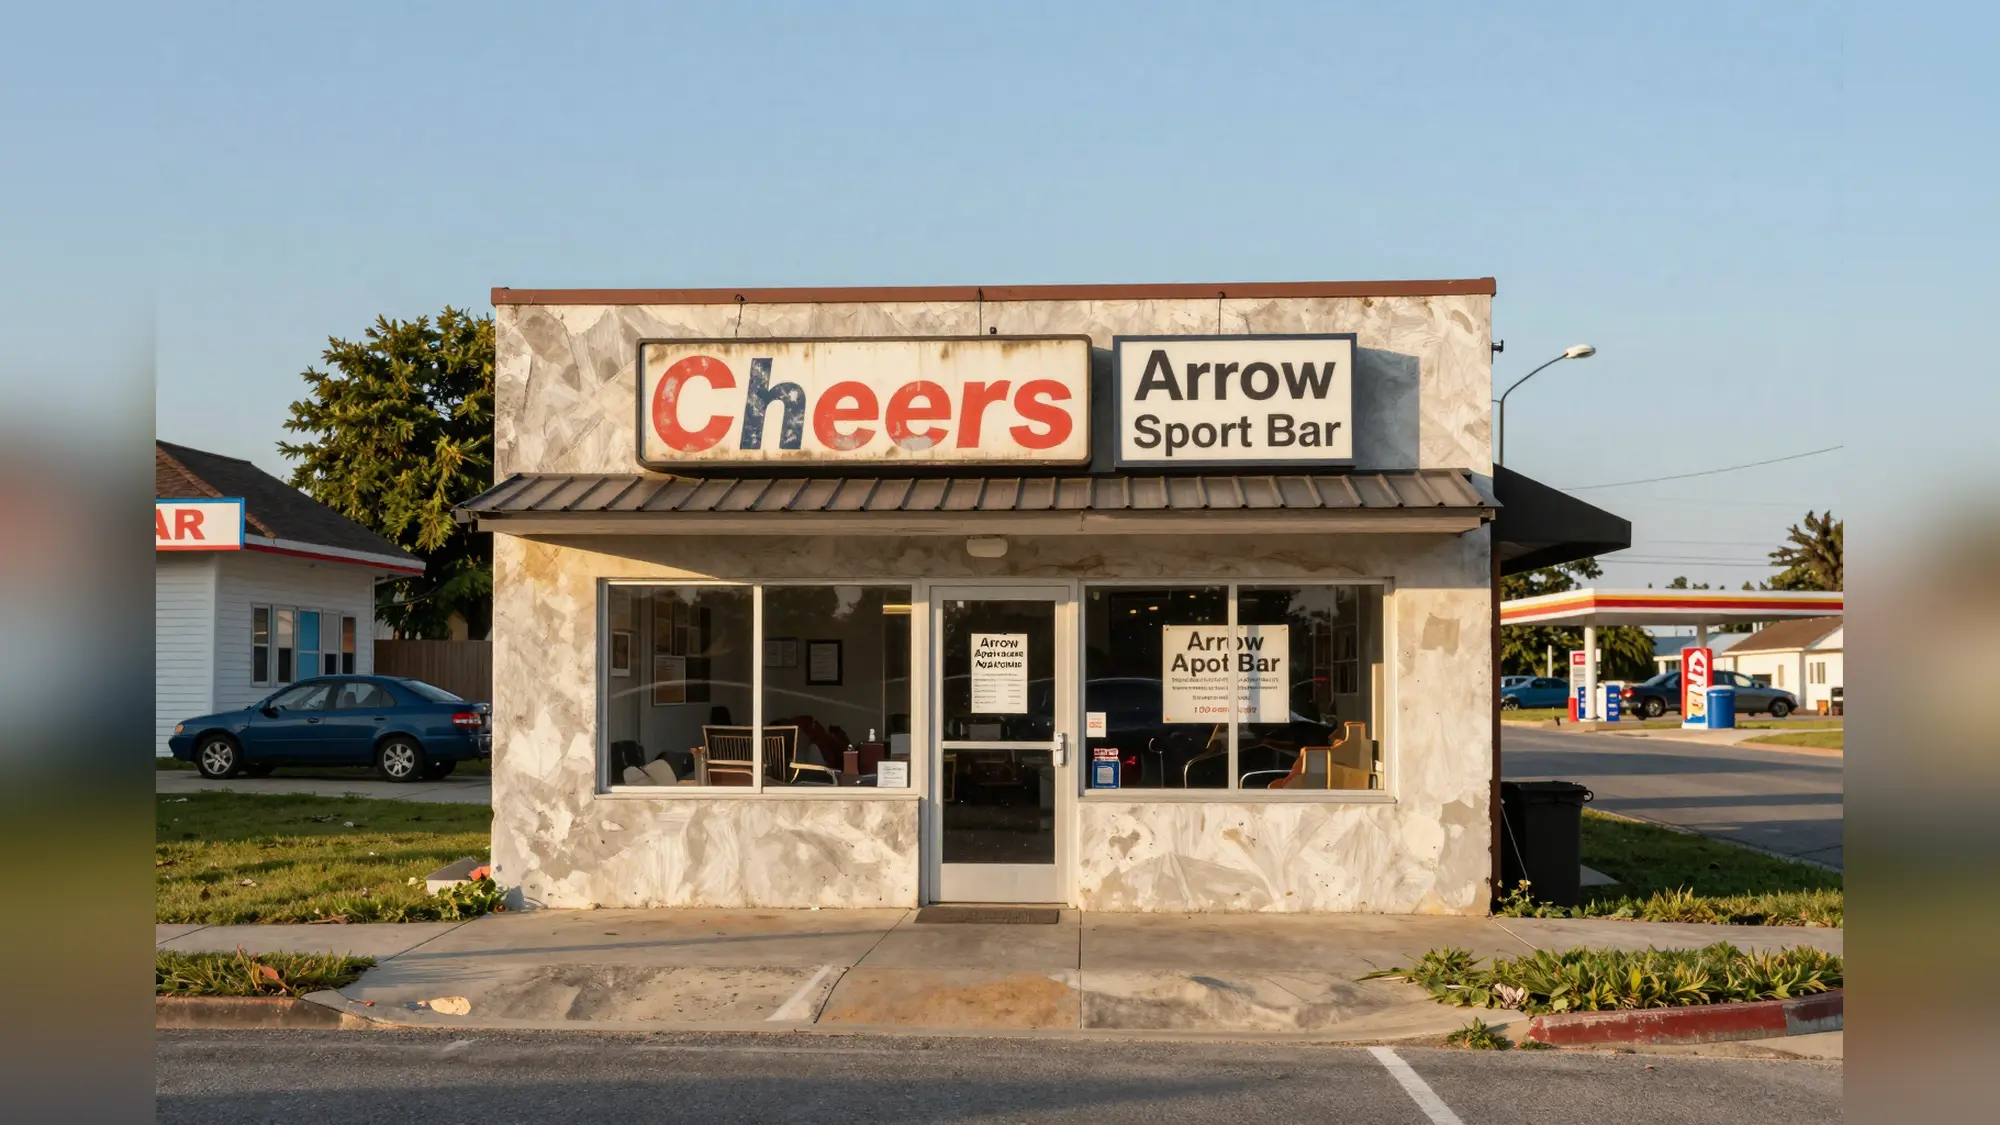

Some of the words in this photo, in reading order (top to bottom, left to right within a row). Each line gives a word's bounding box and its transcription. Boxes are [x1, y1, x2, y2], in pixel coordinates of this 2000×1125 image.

[1134, 349, 1336, 401] Arrow
[652, 355, 1073, 453] Cheers
[1133, 413, 1253, 457] Sport
[1267, 415, 1341, 448] Bar
[980, 637, 1019, 649] Arrow
[1171, 653, 1229, 678] Apot
[1238, 653, 1281, 673] Bar
